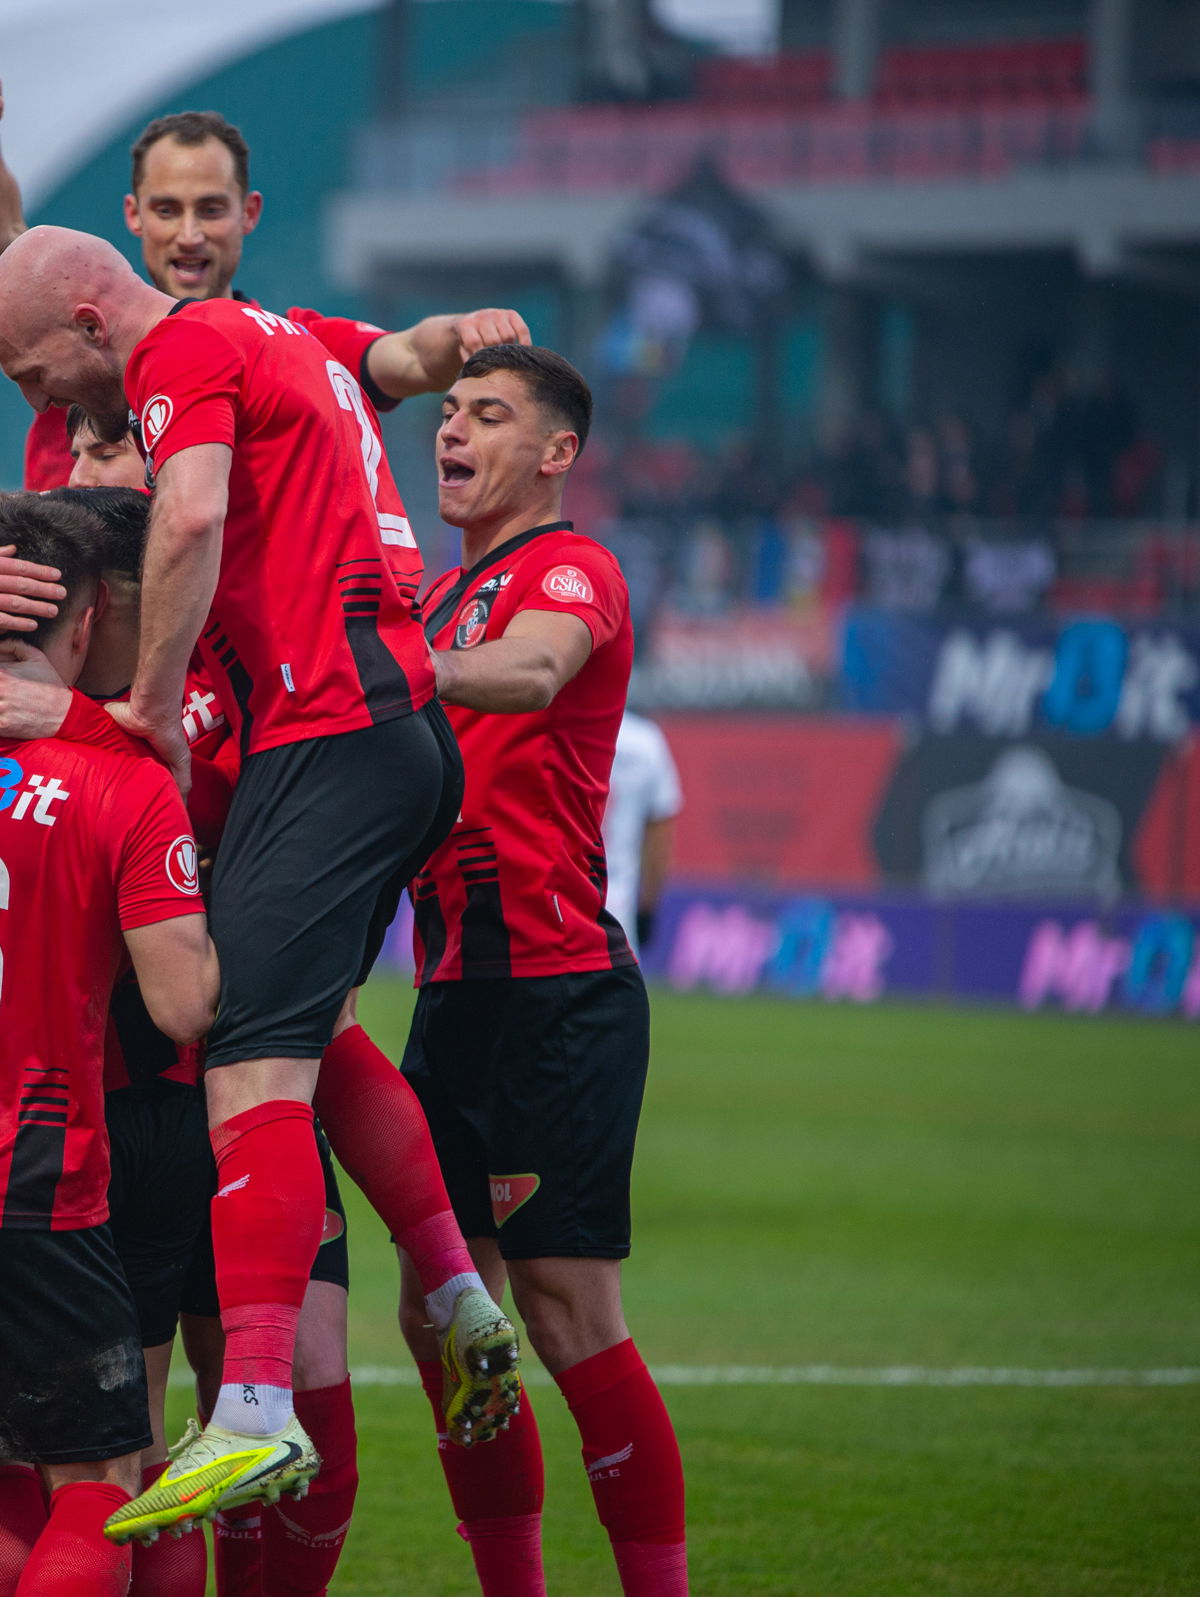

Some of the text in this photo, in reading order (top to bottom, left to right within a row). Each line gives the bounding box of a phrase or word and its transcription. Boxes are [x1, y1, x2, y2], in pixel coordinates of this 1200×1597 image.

[240, 307, 309, 336] Mr
[326, 359, 418, 549] 2
[243, 1384, 259, 1406] KS
